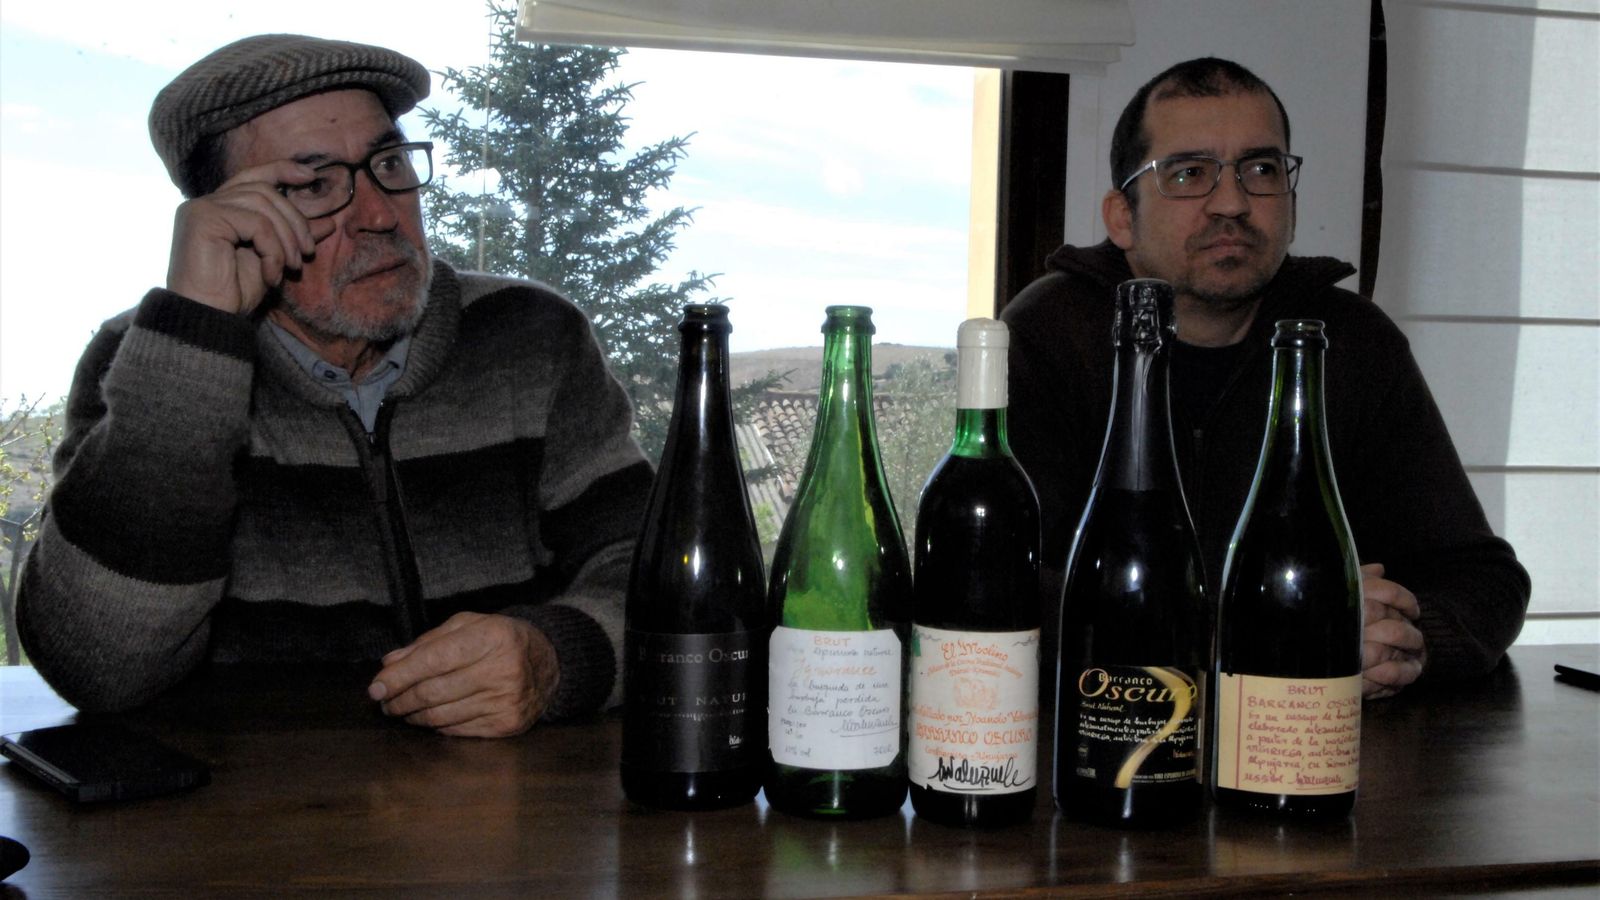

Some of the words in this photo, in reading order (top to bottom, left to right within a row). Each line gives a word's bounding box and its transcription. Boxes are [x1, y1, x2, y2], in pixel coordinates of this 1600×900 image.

[814, 635, 851, 647] BRUT
[957, 639, 1009, 662] Molino
[1098, 672, 1153, 686] Barranco
[1287, 684, 1329, 697] BRUT
[1247, 695, 1321, 710] BARRANCO
